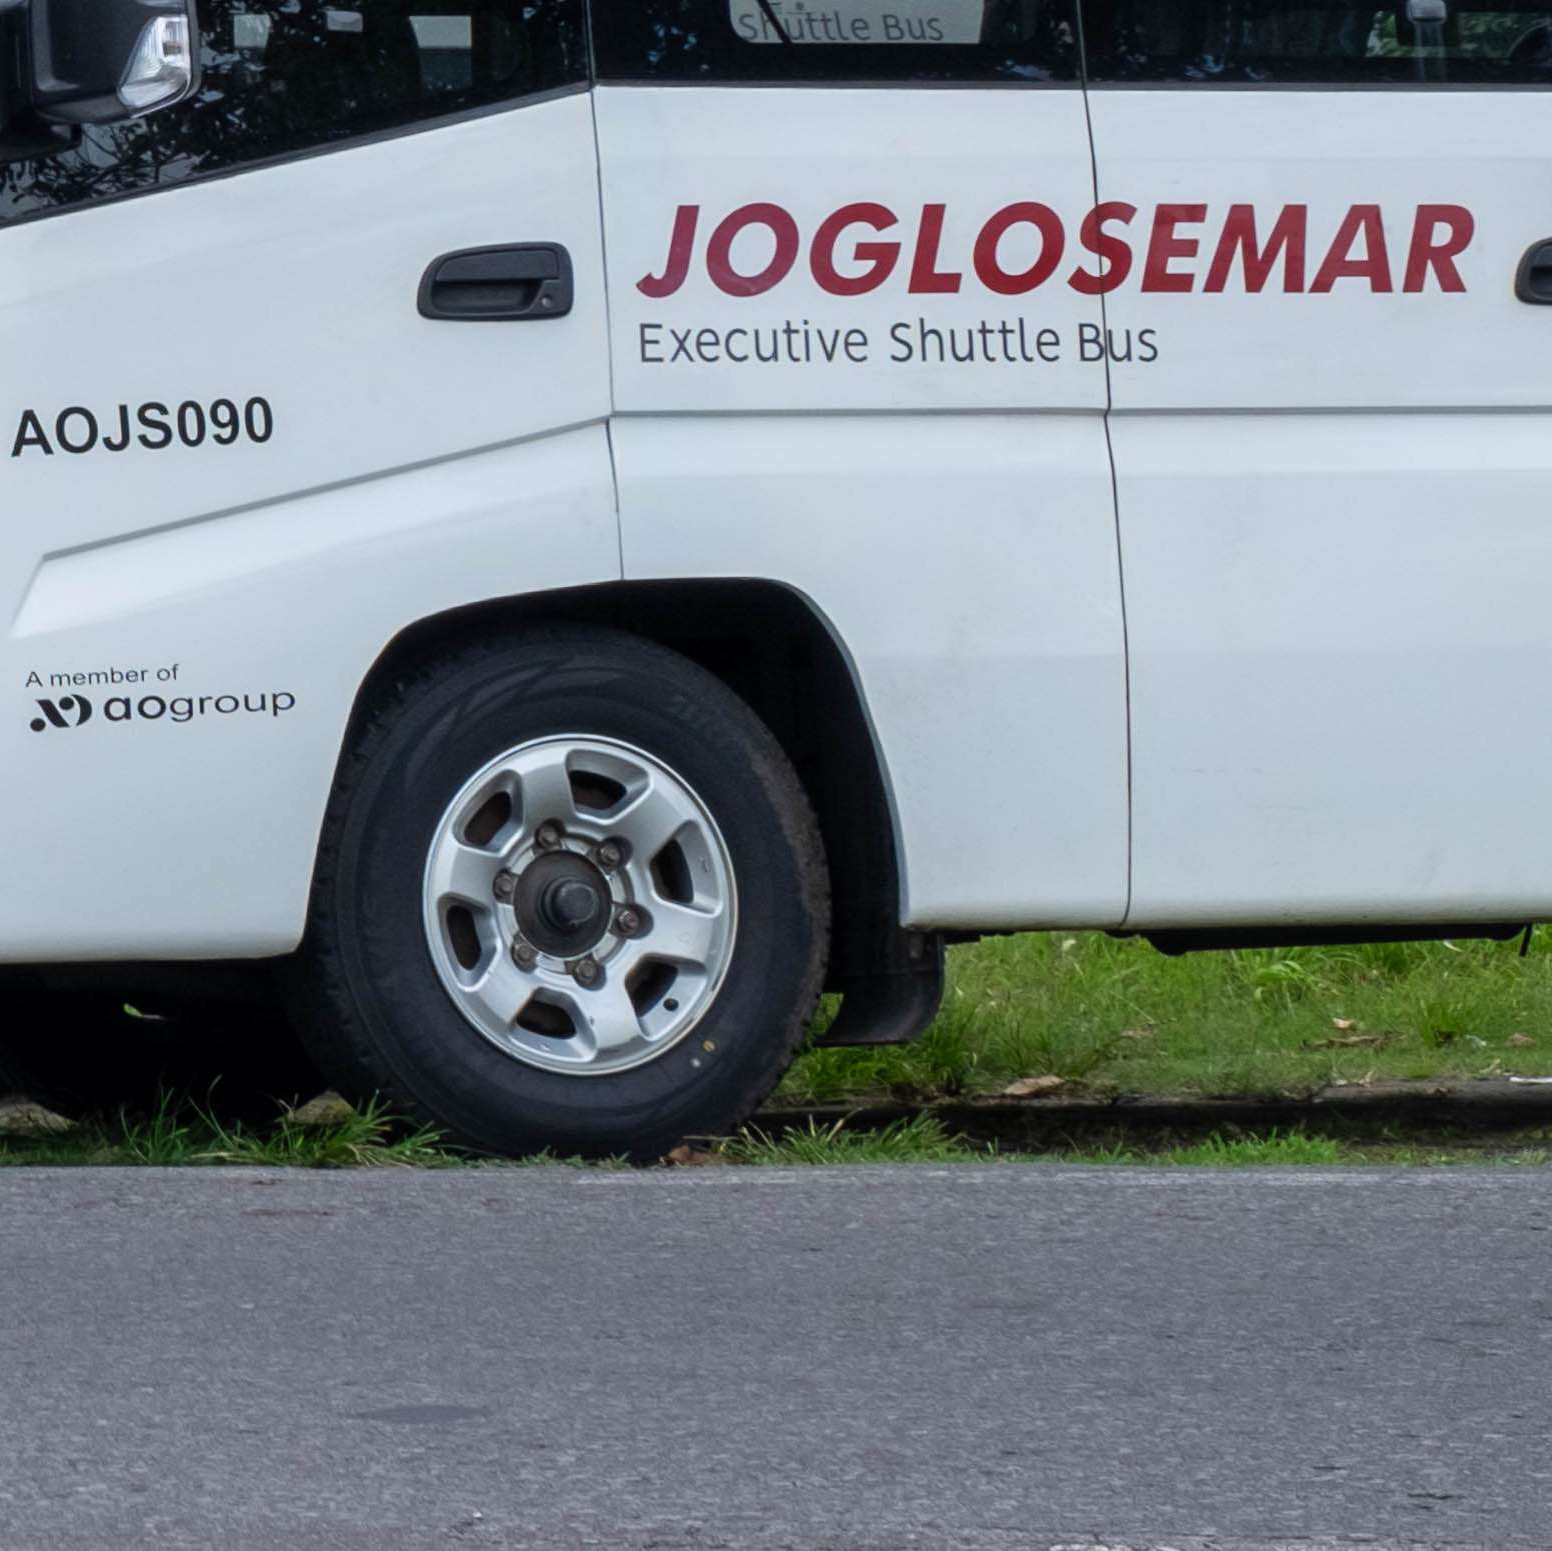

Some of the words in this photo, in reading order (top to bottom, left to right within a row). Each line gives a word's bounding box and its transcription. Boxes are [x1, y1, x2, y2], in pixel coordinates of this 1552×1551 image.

[883, 14, 944, 41] Bus
[634, 200, 1477, 297] JOGLOSEMAR
[637, 320, 869, 363] Executive
[888, 318, 1061, 363] Shuttle
[1078, 322, 1160, 363] Bus
[11, 396, 273, 457] AOJS090
[24, 669, 44, 689] A
[48, 666, 150, 688] member
[155, 663, 181, 682] of
[103, 689, 296, 723] aogroup
